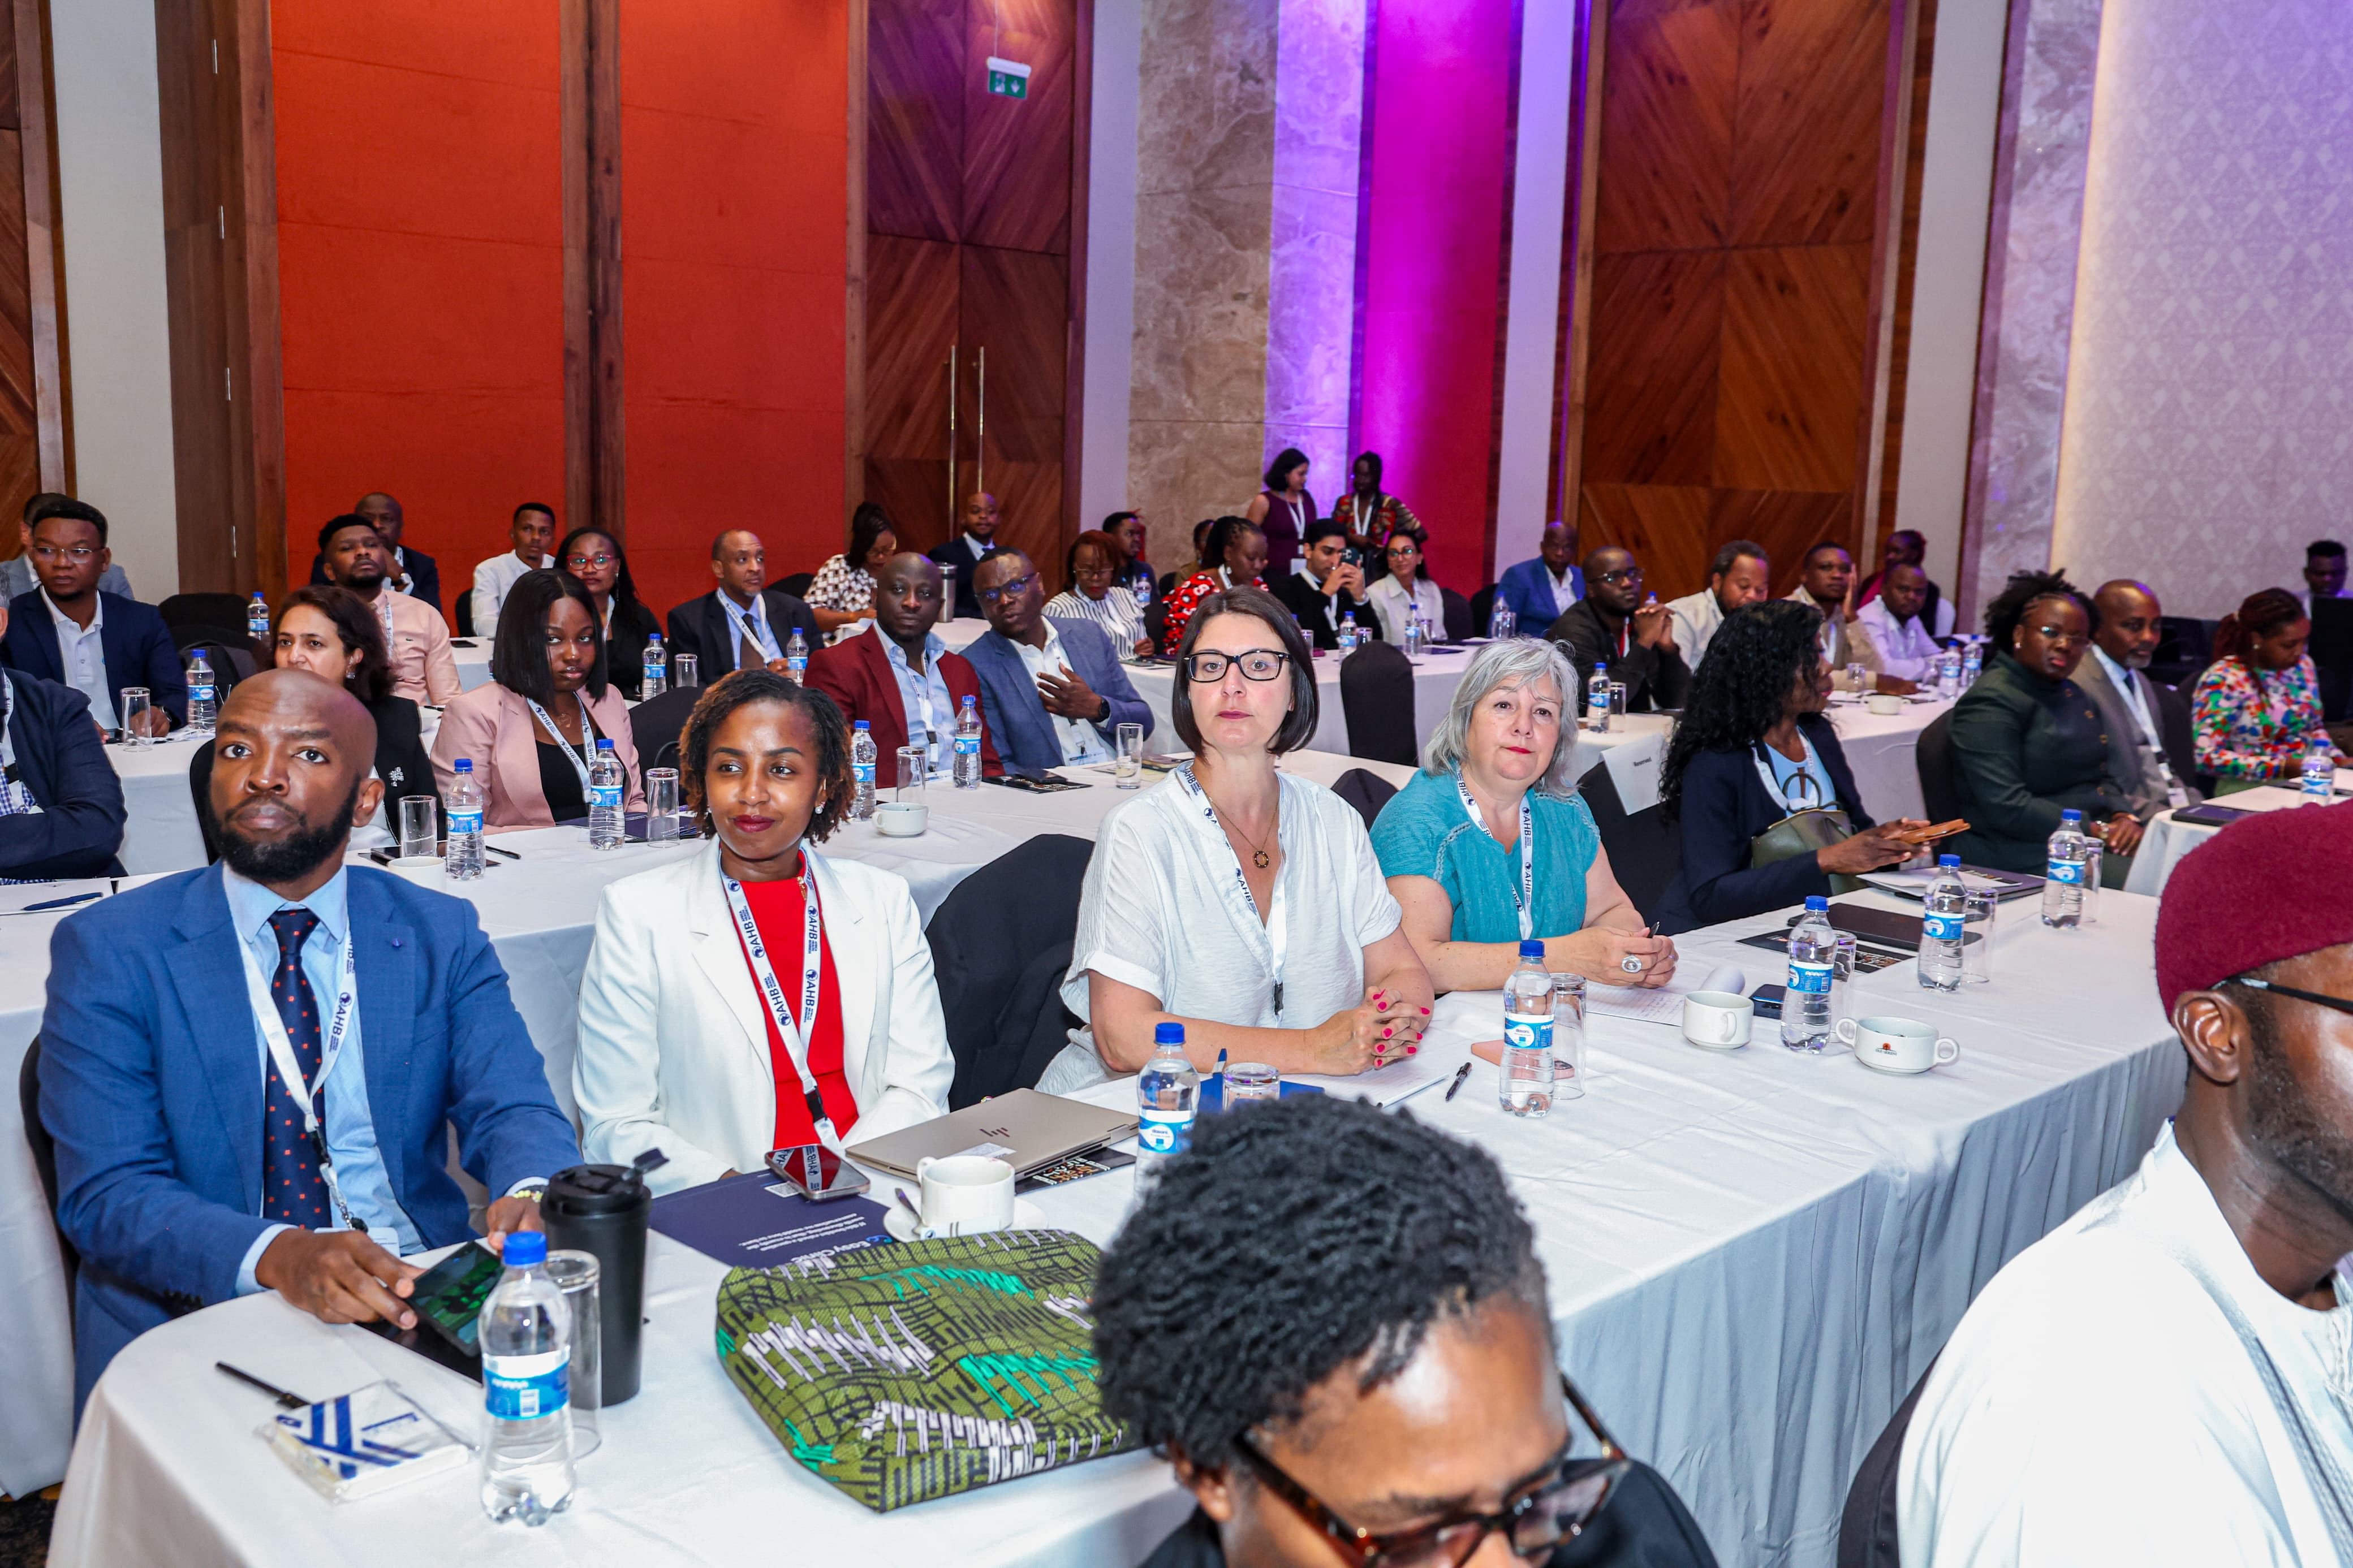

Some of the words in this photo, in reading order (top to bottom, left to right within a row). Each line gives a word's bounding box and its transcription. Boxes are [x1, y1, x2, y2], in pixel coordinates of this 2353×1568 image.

[540, 714, 551, 727] AHB
[564, 747, 576, 759] AHB
[1634, 757, 1652, 766] Reserved
[1183, 769, 1196, 784] AHB
[1459, 782, 1471, 796] AHB
[1238, 880, 1252, 902] AHB
[744, 921, 760, 945] AHB
[809, 916, 817, 939] AHB
[769, 988, 787, 1013] AHB
[805, 981, 816, 1006] AHB
[333, 1005, 347, 1035] AHB
